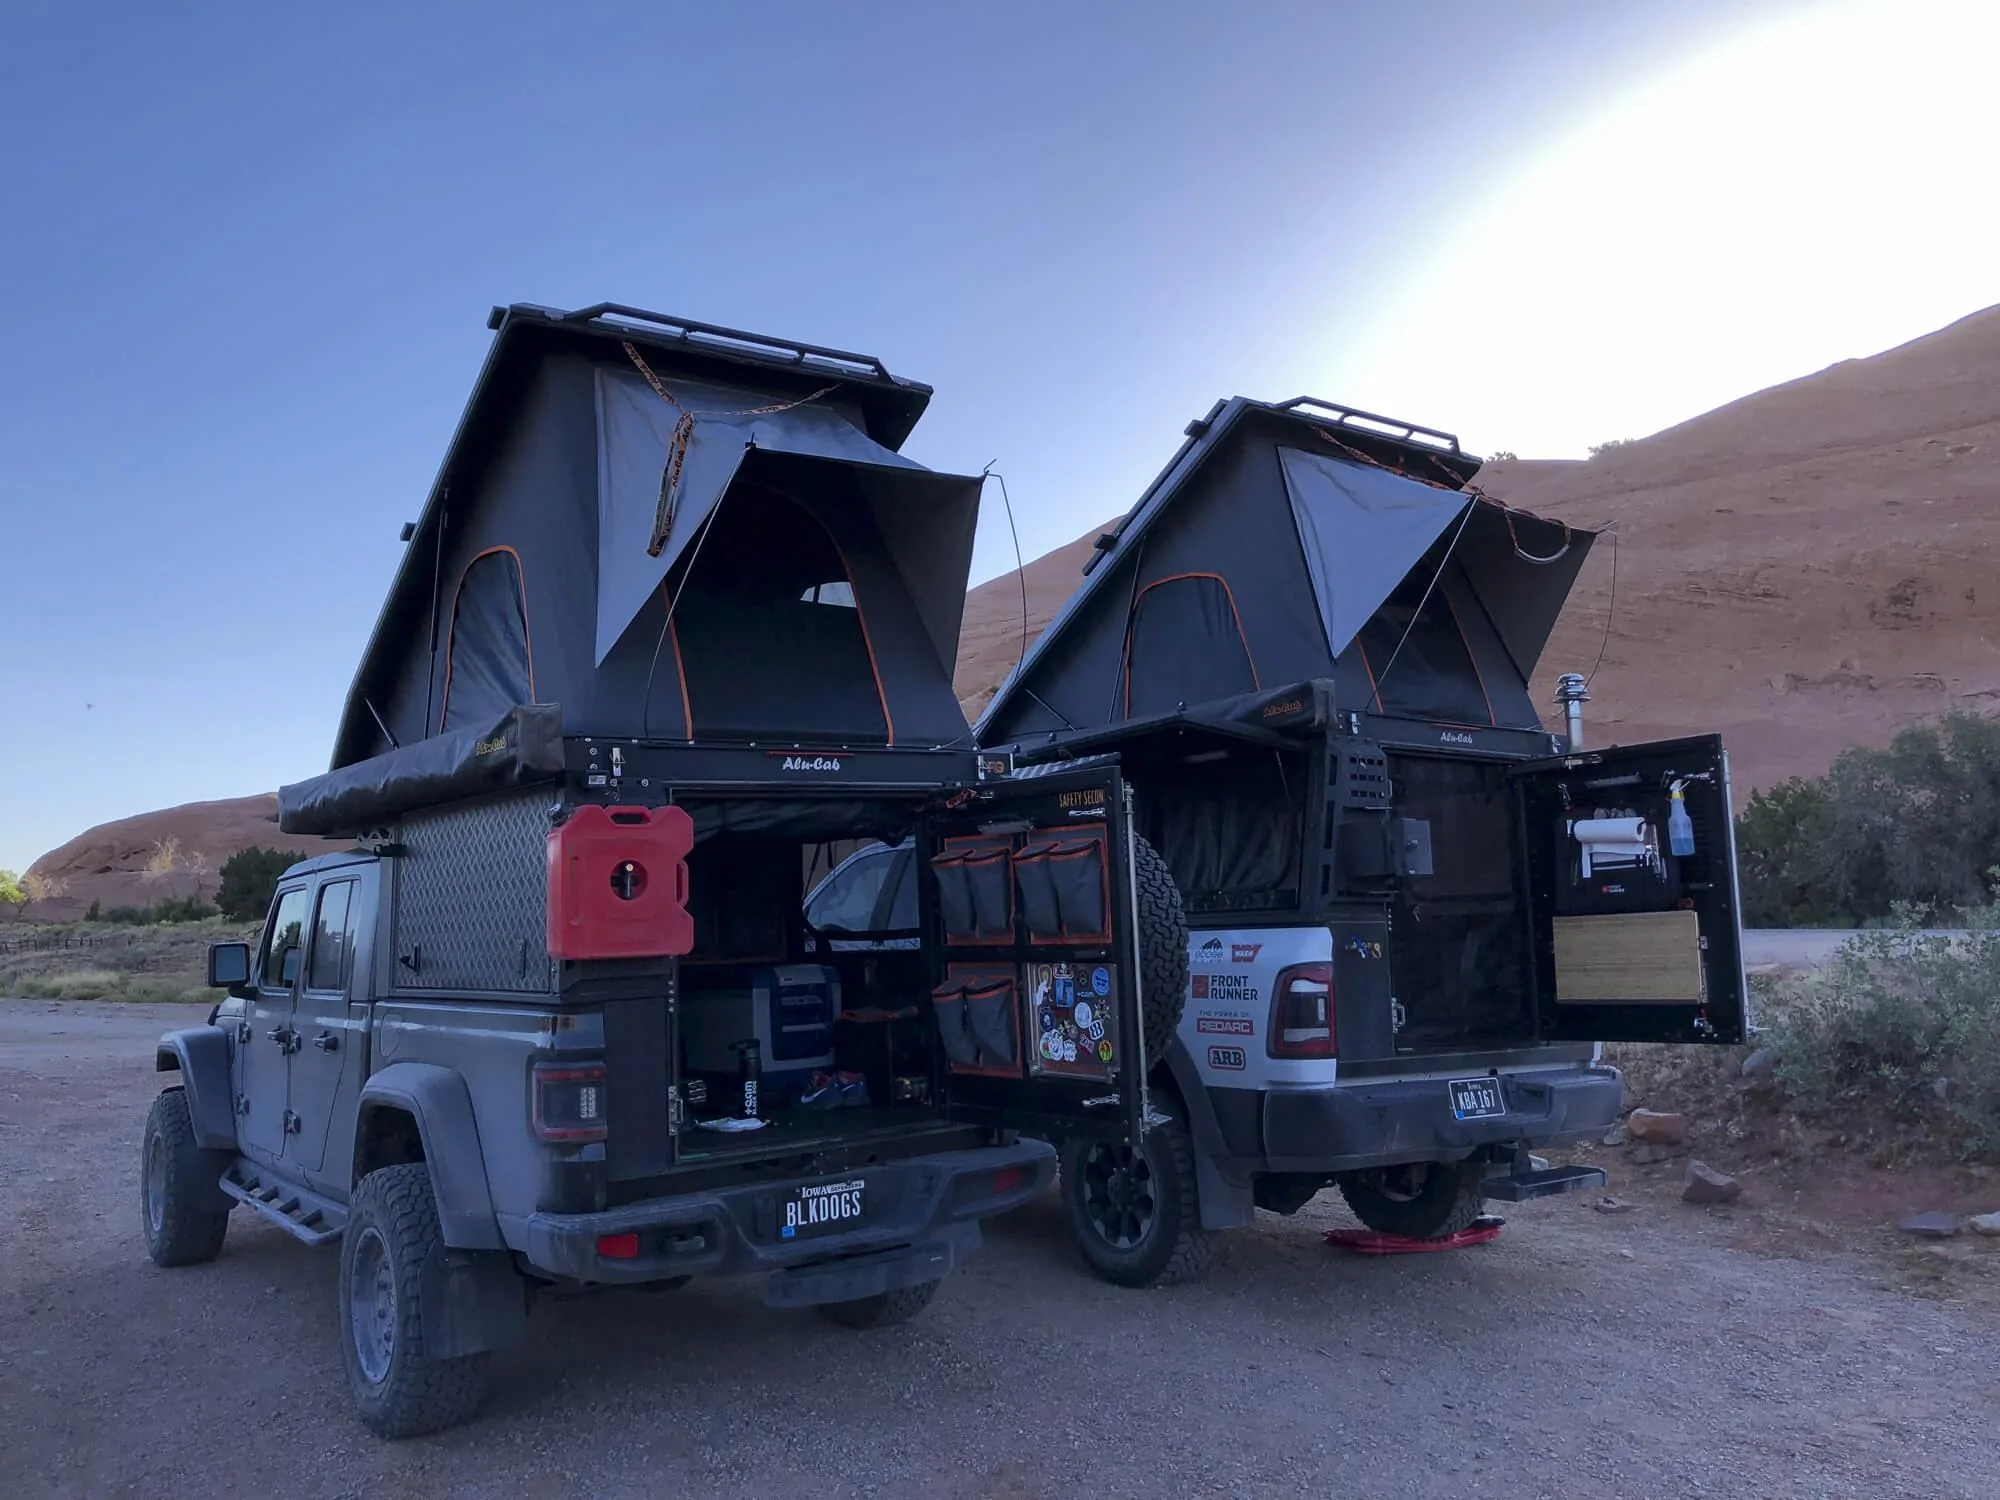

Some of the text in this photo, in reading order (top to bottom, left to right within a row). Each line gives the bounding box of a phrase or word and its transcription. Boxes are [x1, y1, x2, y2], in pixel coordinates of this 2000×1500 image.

[782, 756, 841, 771] Alu-Cab
[1059, 791, 1082, 808] SAFETY
[1210, 975, 1249, 988] FRONT
[1210, 987, 1259, 1001] RUNNER
[1199, 1020, 1251, 1033] REDARC
[1211, 1049, 1243, 1067] ARB
[1457, 1089, 1496, 1110] KBA 167
[786, 1191, 861, 1227] BLKDOGS
